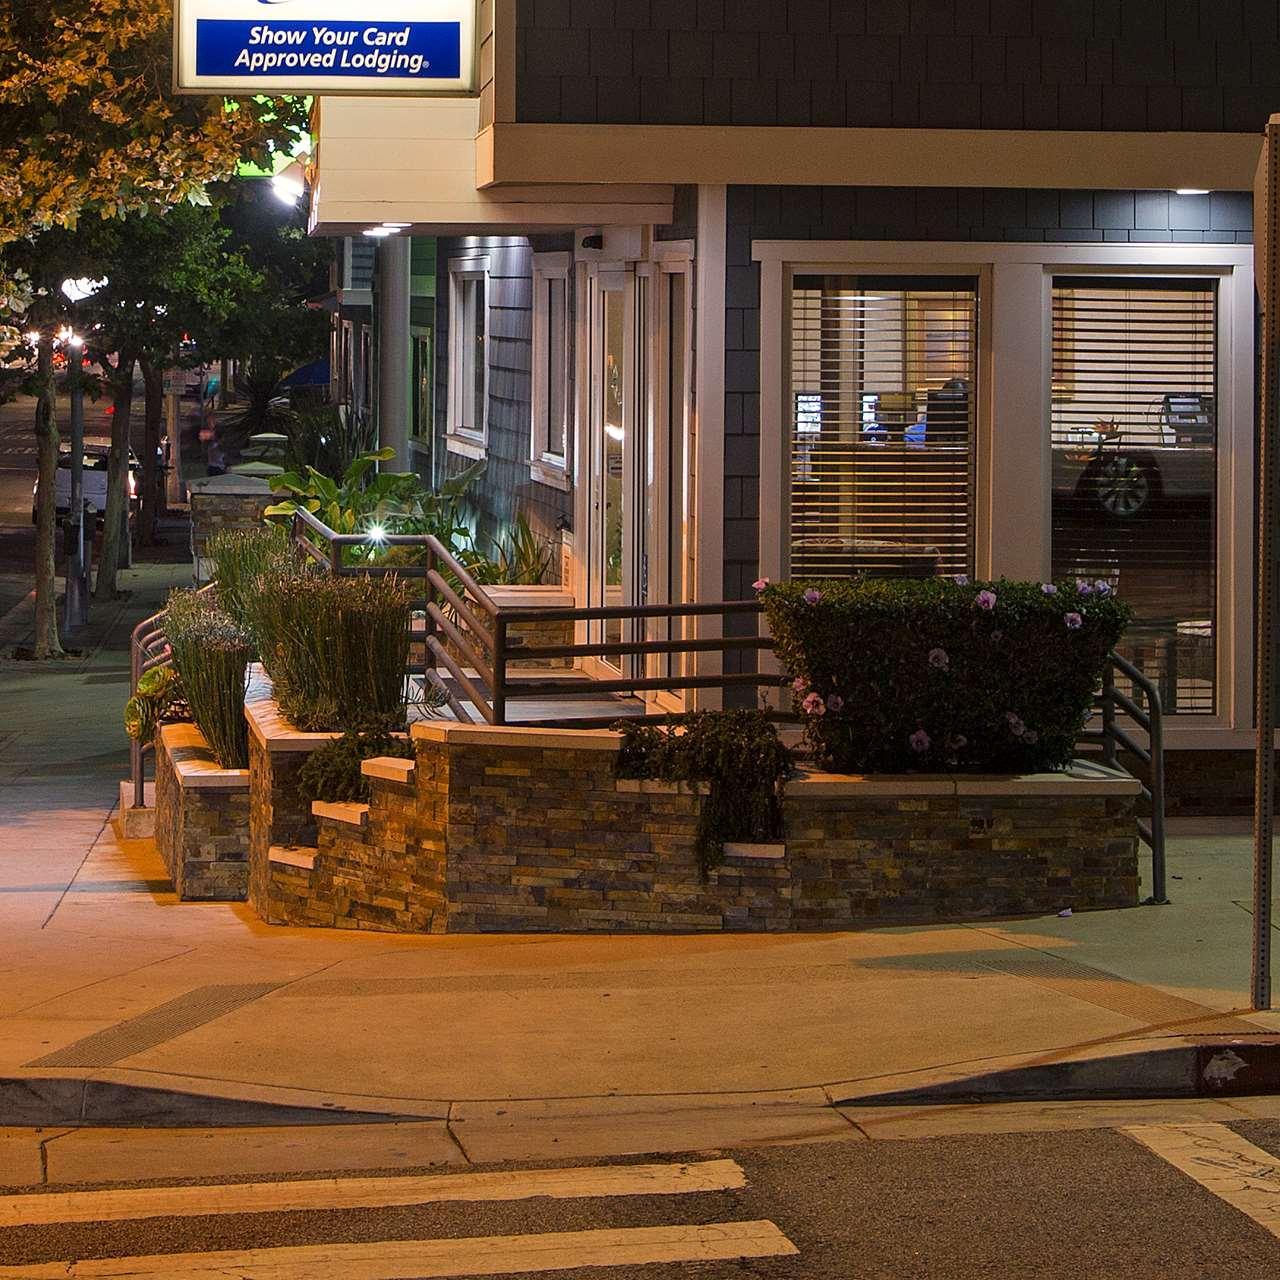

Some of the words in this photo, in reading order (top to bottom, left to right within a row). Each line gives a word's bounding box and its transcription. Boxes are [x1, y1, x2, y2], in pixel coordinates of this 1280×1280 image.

[248, 25, 307, 45] Show
[312, 27, 359, 45] Your
[362, 27, 411, 47] Card
[234, 49, 336, 72] Approved
[339, 50, 425, 74] Lodging
